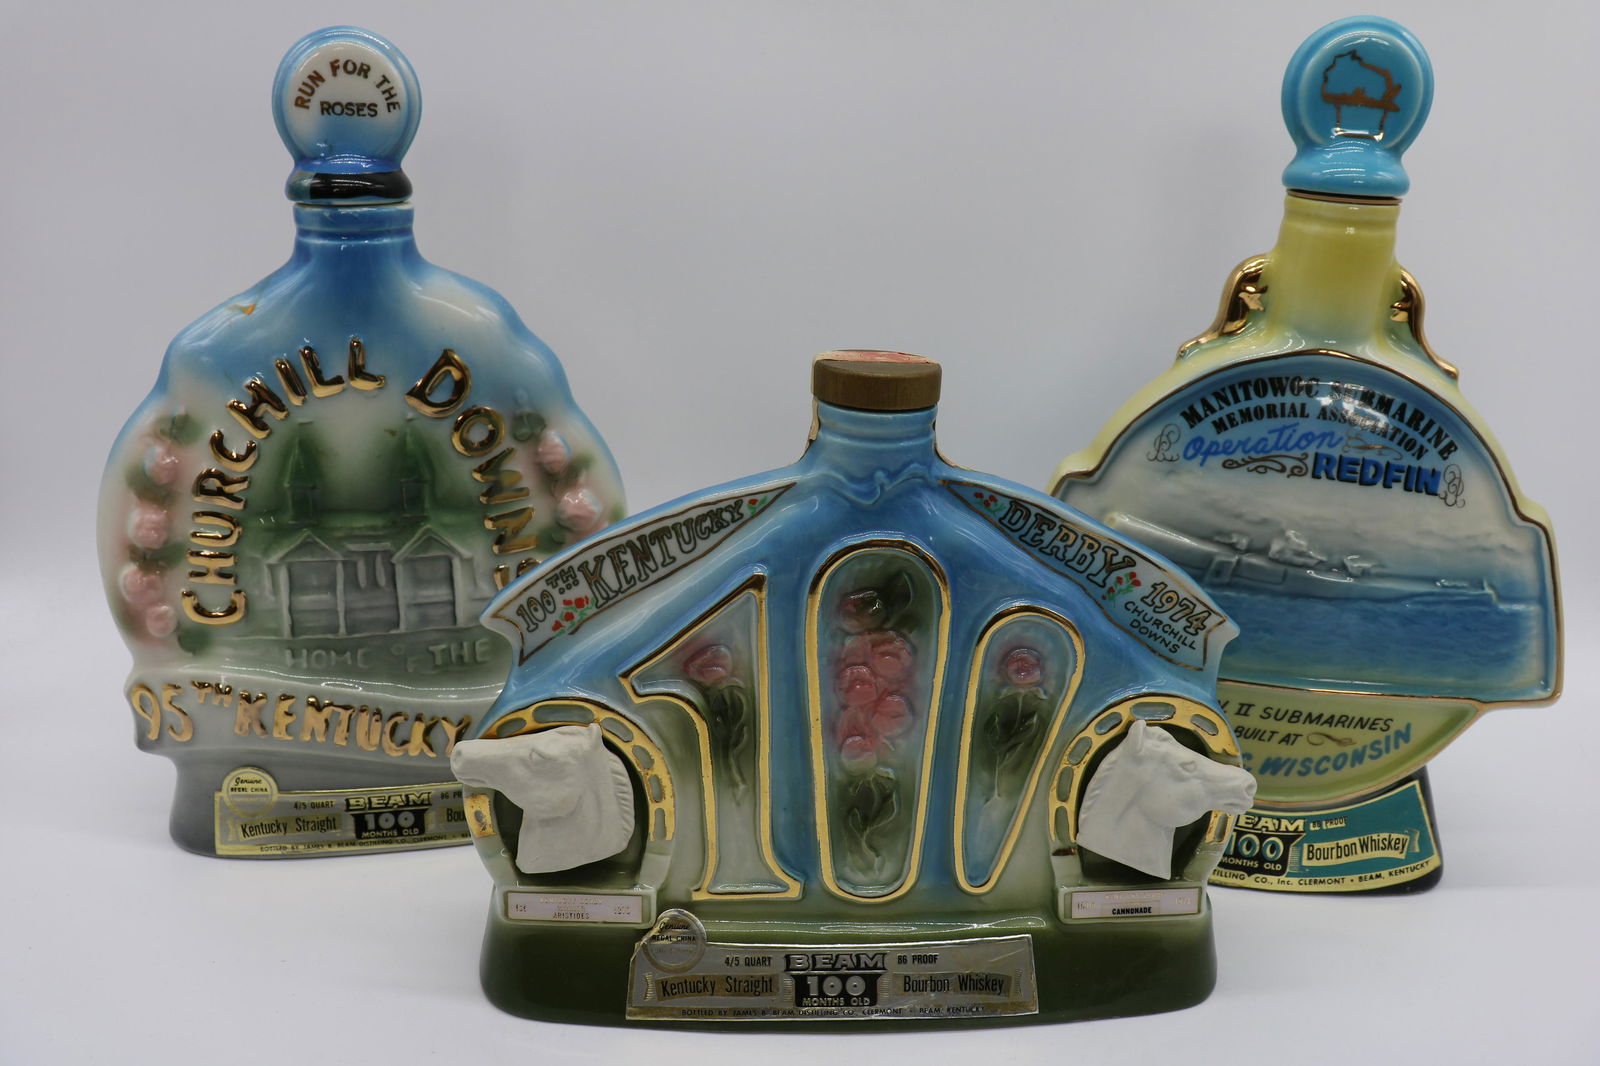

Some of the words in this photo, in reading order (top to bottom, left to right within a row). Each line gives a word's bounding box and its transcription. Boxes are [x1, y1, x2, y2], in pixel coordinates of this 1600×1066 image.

[294, 70, 326, 110] RUN
[329, 59, 371, 79] FOR
[375, 74, 401, 113] THE
[320, 101, 378, 117] ROSES
[1178, 375, 1320, 429] MANITOWOC
[1211, 401, 1310, 435] MEMORIAL
[1183, 422, 1344, 467] Operation
[181, 337, 386, 626] CHURCHILL
[1312, 452, 1443, 497] REDFIN
[578, 499, 743, 609] KENTUCKY
[998, 501, 1136, 588] DERBY
[1140, 582, 1211, 637] 1974
[1124, 601, 1197, 651] CHURCHILL
[1129, 618, 1180, 654] DOWNS
[428, 638, 491, 667] THE
[234, 690, 473, 758] KENTUCKY
[1260, 706, 1394, 732] SUBMARINES
[1234, 725, 1279, 743] BUILT
[1278, 731, 1303, 747] AT
[1258, 722, 1413, 777] WISCONSIN
[294, 801, 307, 810] 4/5
[310, 800, 334, 809] QUART
[345, 791, 432, 811] BEAM
[241, 818, 288, 838] Kentucky
[295, 816, 337, 833] Straight
[364, 811, 415, 830] 100
[1236, 813, 1305, 832] EAM
[361, 829, 398, 839] MONTHS
[402, 828, 419, 836] OLD
[1306, 841, 1357, 861] Bourbon
[1360, 835, 1410, 855] Whiskey
[1212, 868, 1246, 881] TILLING
[1298, 877, 1346, 886] CLERMONT
[1388, 860, 1431, 877] KENTUCKY
[1220, 856, 1259, 868] MONTHS
[1263, 862, 1282, 871] OLD
[1112, 906, 1152, 915] CANNONADE
[660, 921, 690, 933] Genuine
[724, 957, 740, 967] 4/5
[744, 956, 772, 967] QUART
[784, 952, 888, 972] BEAM
[912, 954, 939, 964] PROOF
[661, 976, 716, 997] Kentucky
[725, 975, 773, 996] Straight
[807, 975, 866, 996] 100
[903, 975, 950, 994] Bourbon
[958, 973, 1004, 995] Whiskey
[733, 1009, 757, 1017] JAMES
[862, 1008, 903, 1016] CLERMONT
[802, 997, 845, 1006] MONTHS
[850, 997, 870, 1006] OLD
